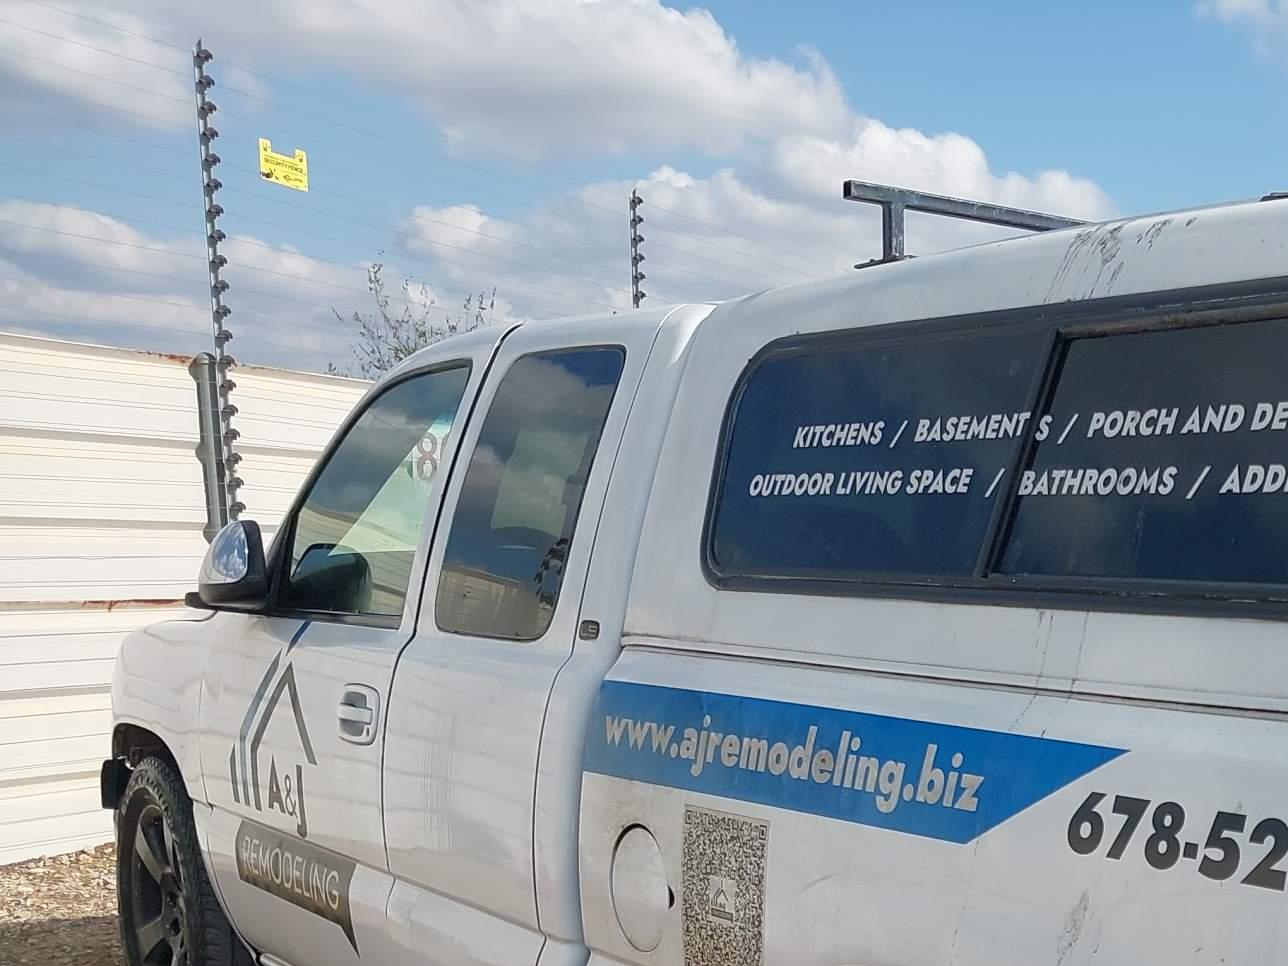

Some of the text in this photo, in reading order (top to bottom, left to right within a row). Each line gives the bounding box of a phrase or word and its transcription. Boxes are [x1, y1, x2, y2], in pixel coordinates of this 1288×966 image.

[793, 421, 885, 448] KITCHENS
[914, 412, 1050, 444] BASEMENTS
[1087, 405, 1179, 439] PORCH
[1180, 403, 1241, 434] AND
[749, 472, 834, 497] OUTDOOR
[836, 470, 902, 495] LIVING
[905, 468, 971, 495] SPACE
[1018, 465, 1177, 496] BATHROOMS
[268, 754, 308, 838] A&J
[606, 714, 986, 814] www.ajremodeling.biz
[240, 835, 340, 910] REMODELING
